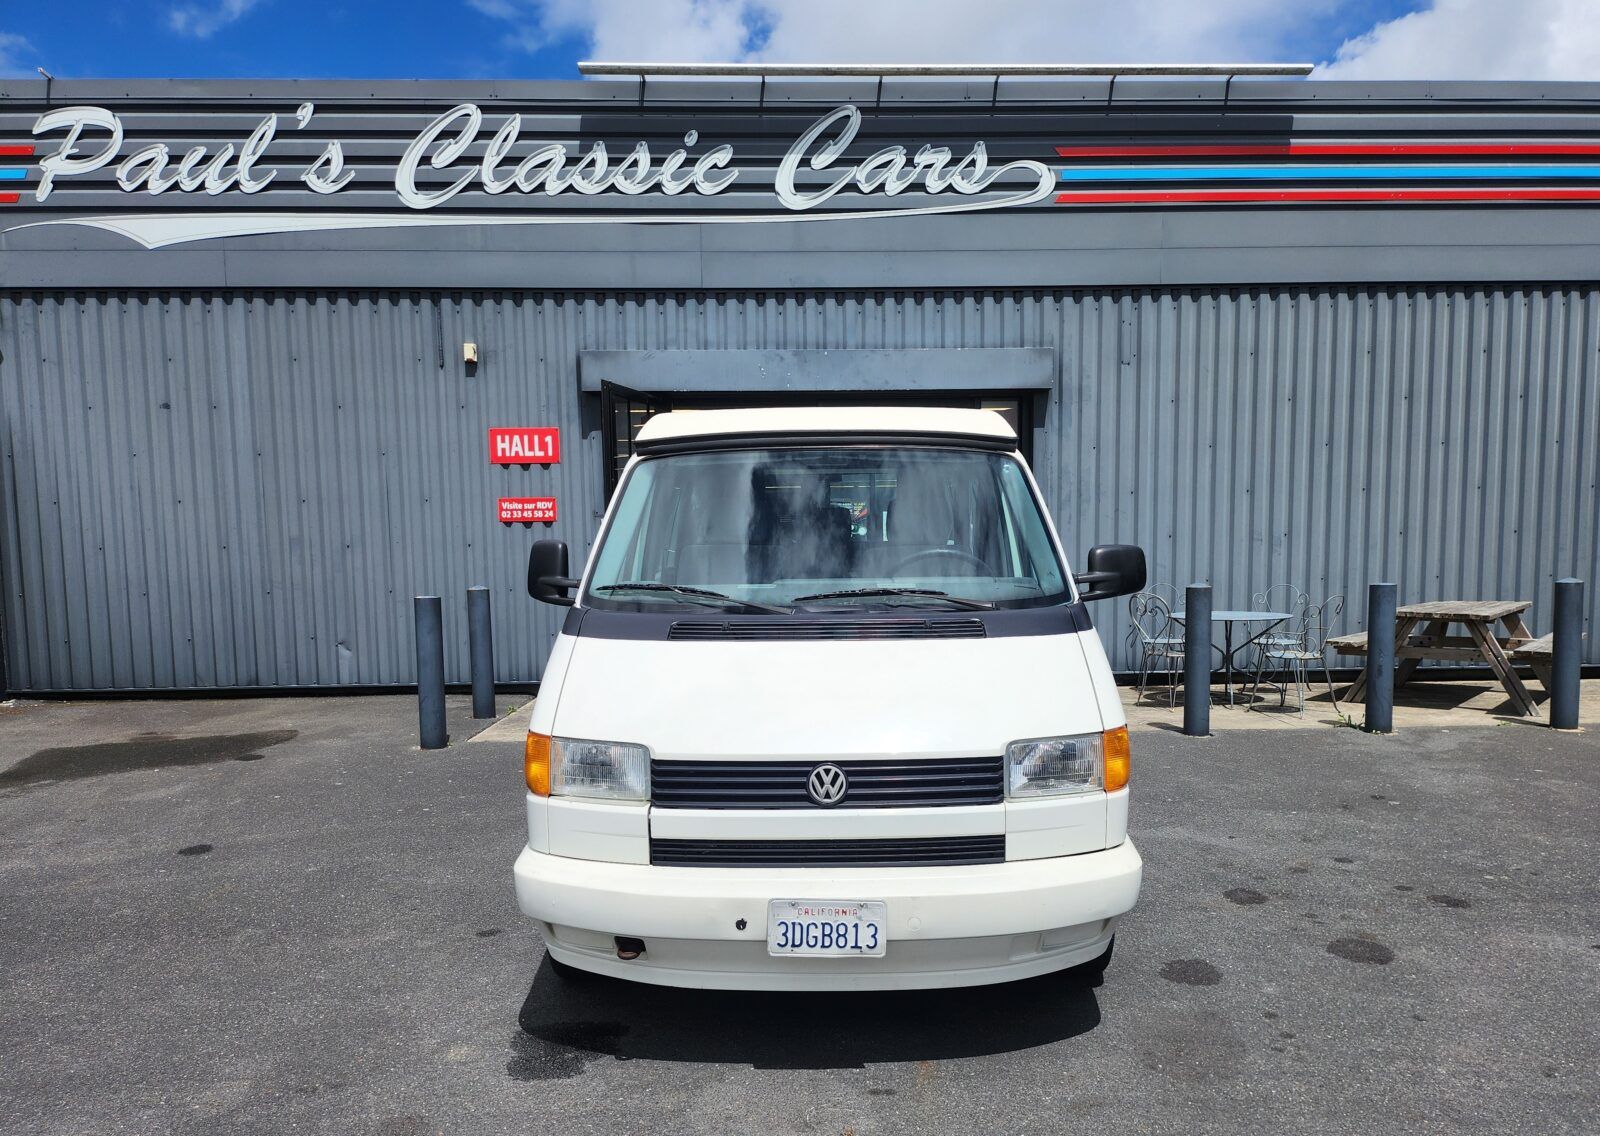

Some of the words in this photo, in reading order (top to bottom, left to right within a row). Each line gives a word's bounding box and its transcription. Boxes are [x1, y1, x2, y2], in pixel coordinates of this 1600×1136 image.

[32, 103, 356, 203] Paul's
[394, 103, 740, 210] Classic
[774, 104, 1057, 210] Cars
[501, 502, 523, 510] Visite
[536, 501, 553, 509] RDV
[501, 510, 511, 518] 02
[512, 510, 522, 518] 33
[522, 510, 533, 518] 45
[533, 510, 543, 518] 58
[543, 510, 554, 518] 24
[808, 765, 847, 804] VW
[797, 907, 858, 917] CALIFORNIA
[777, 921, 879, 950] 3DGB813
